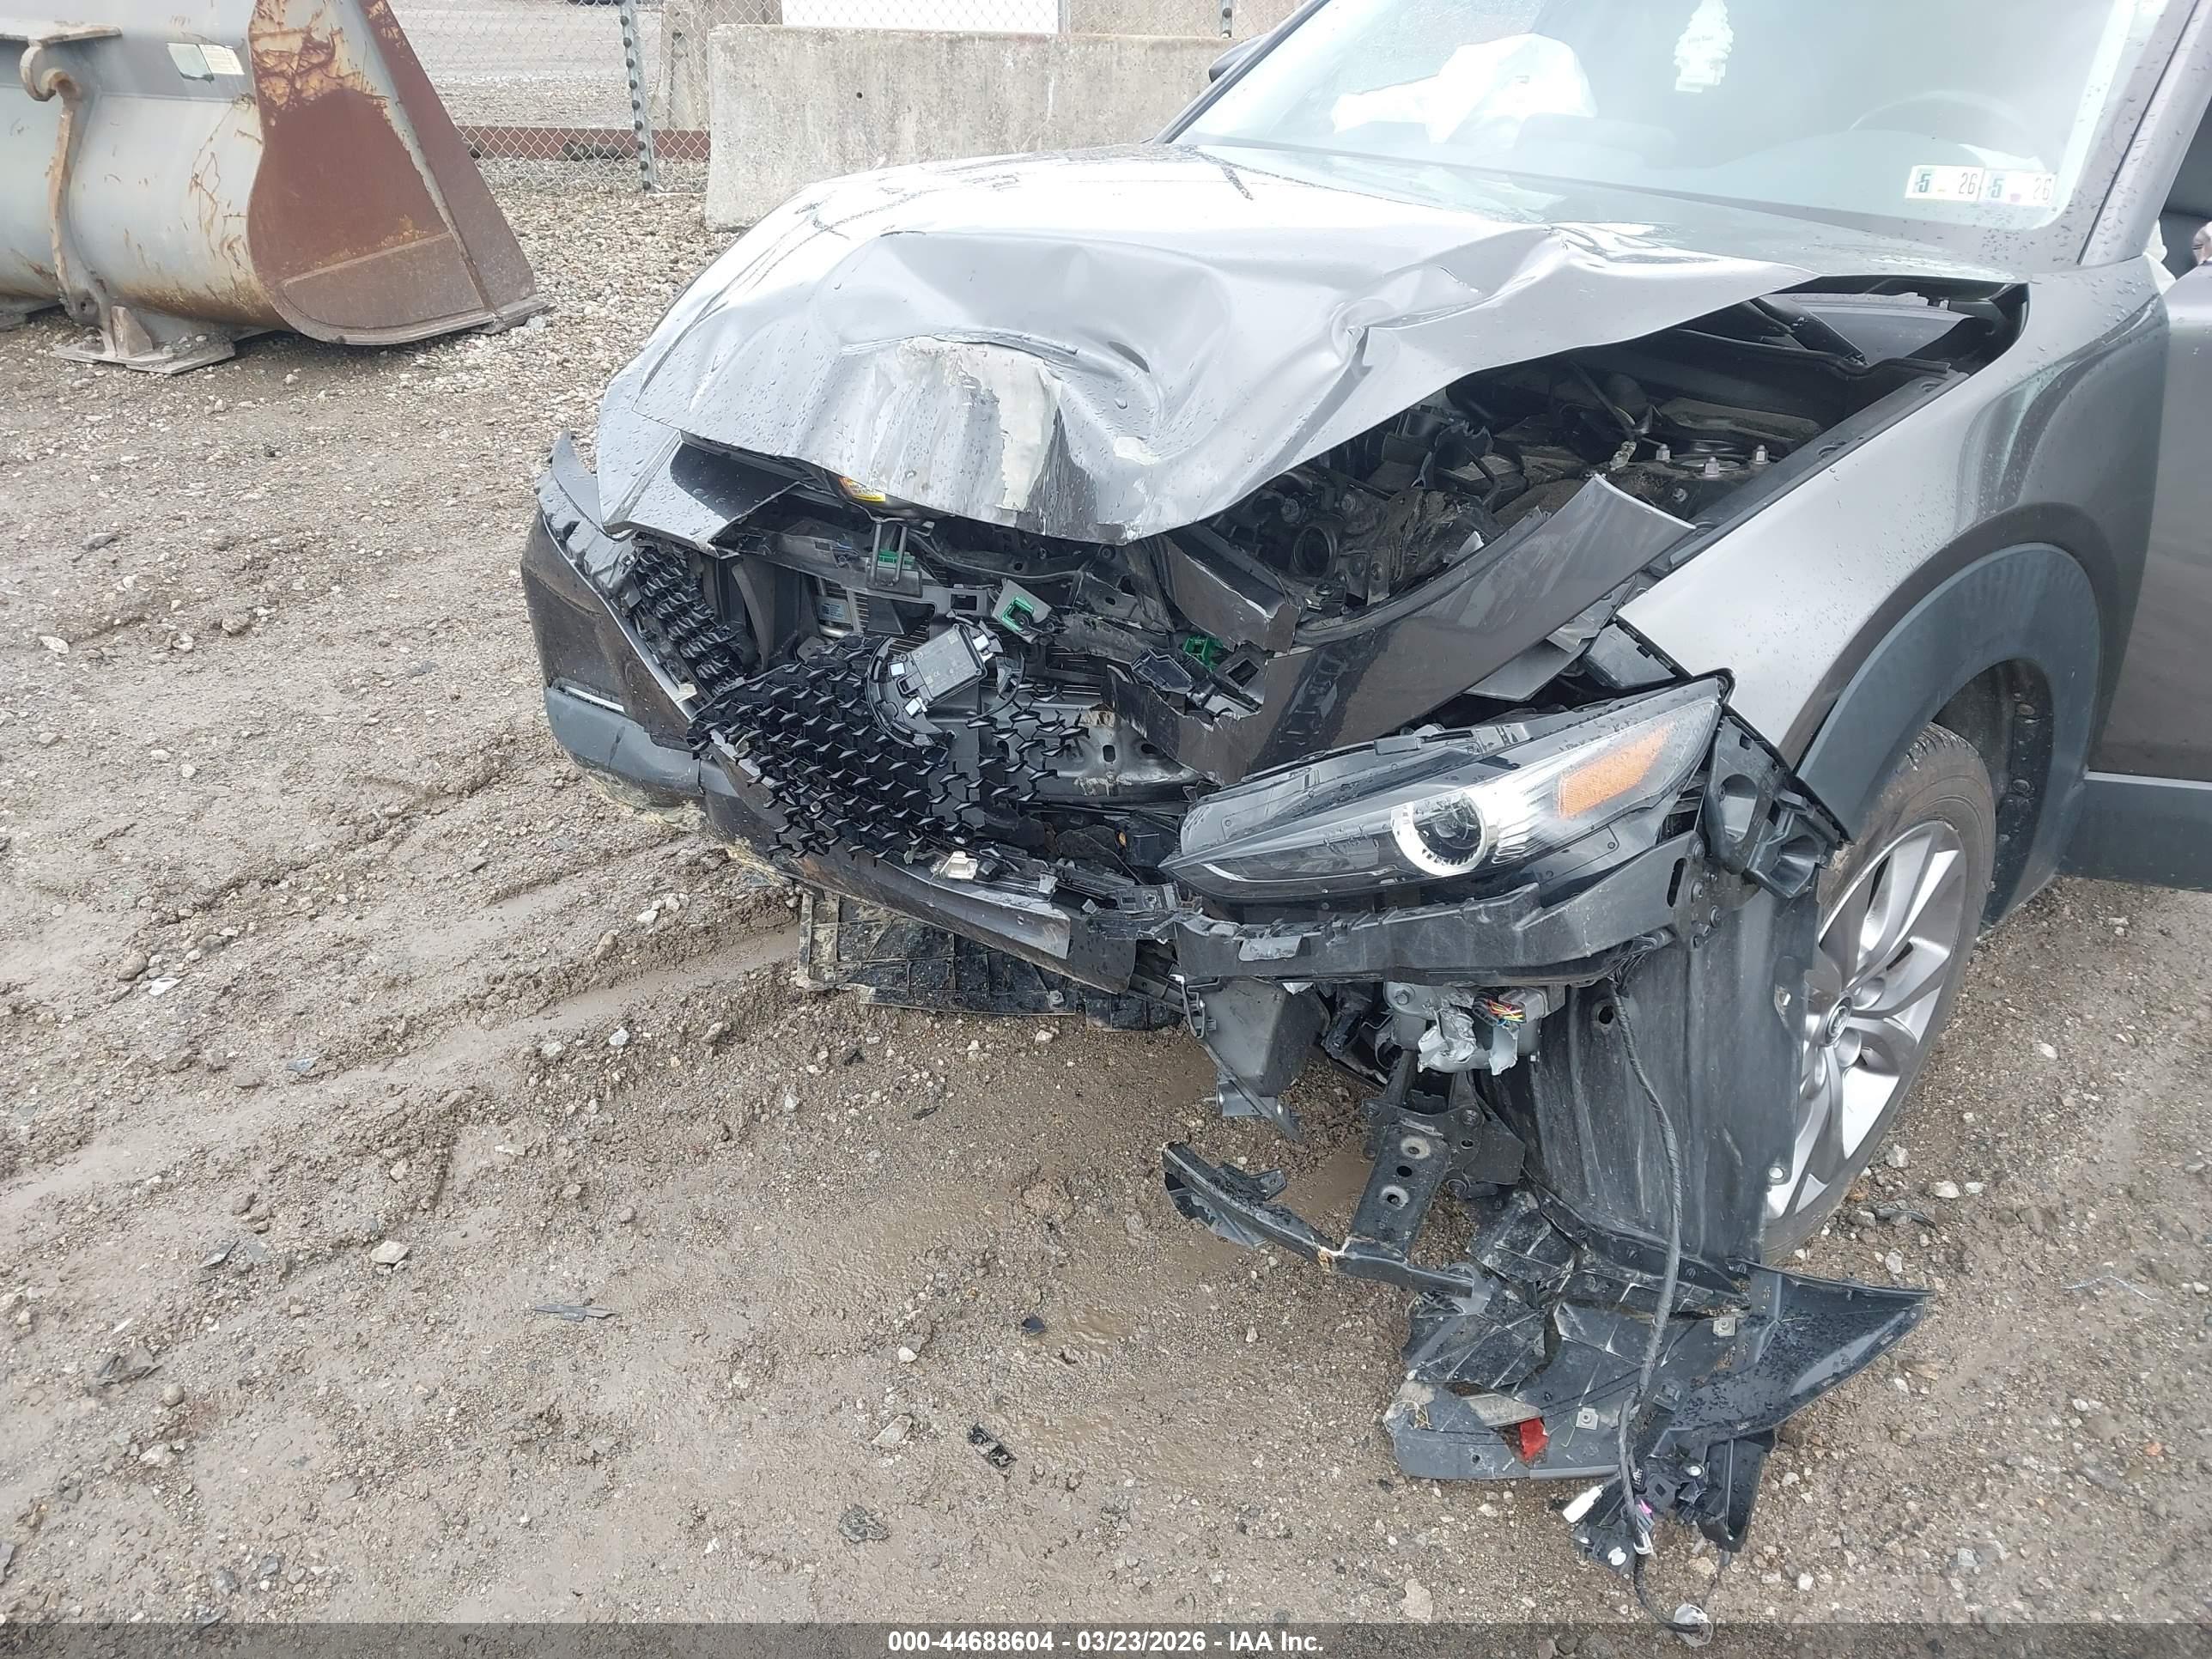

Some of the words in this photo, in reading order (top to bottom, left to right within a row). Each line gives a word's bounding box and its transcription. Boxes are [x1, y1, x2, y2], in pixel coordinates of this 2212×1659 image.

[1918, 173, 1931, 193] 5
[1958, 172, 1978, 195] 26
[1990, 178, 2004, 198] 5
[2033, 177, 2052, 200] 26
